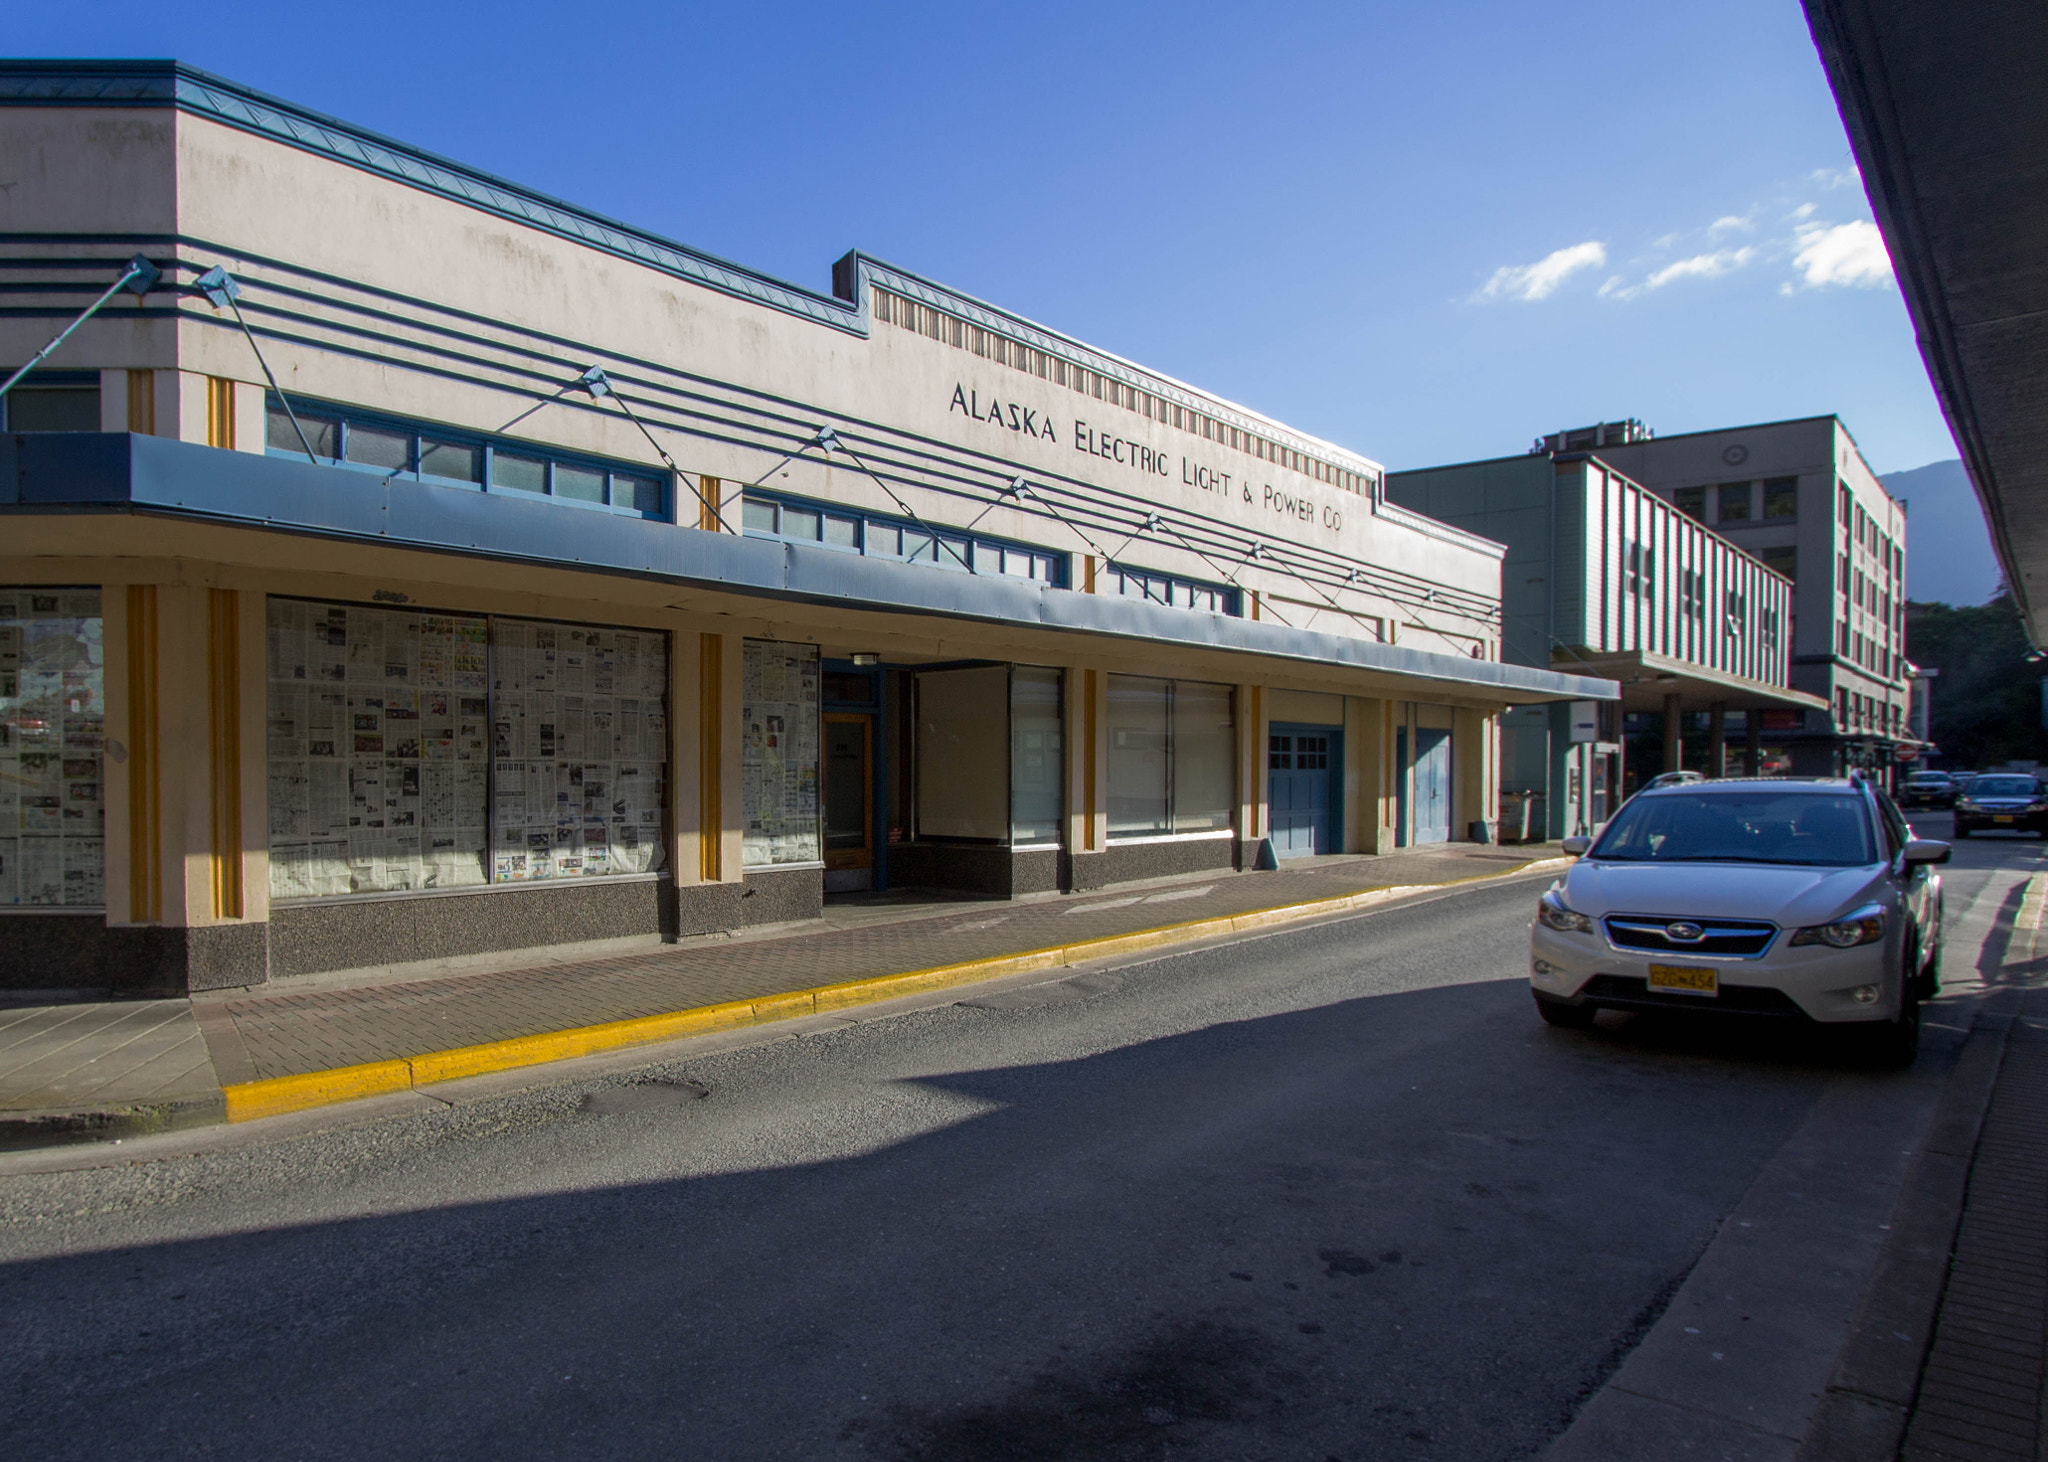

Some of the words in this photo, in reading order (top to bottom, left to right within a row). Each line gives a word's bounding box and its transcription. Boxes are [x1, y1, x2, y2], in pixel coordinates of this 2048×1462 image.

[949, 381, 1057, 443] ALASKA
[1075, 419, 1168, 477] ELECTRIC
[1182, 456, 1231, 496] LIGHT
[1243, 481, 1253, 504] &
[1264, 484, 1314, 524] POWER
[1323, 505, 1342, 531] CO
